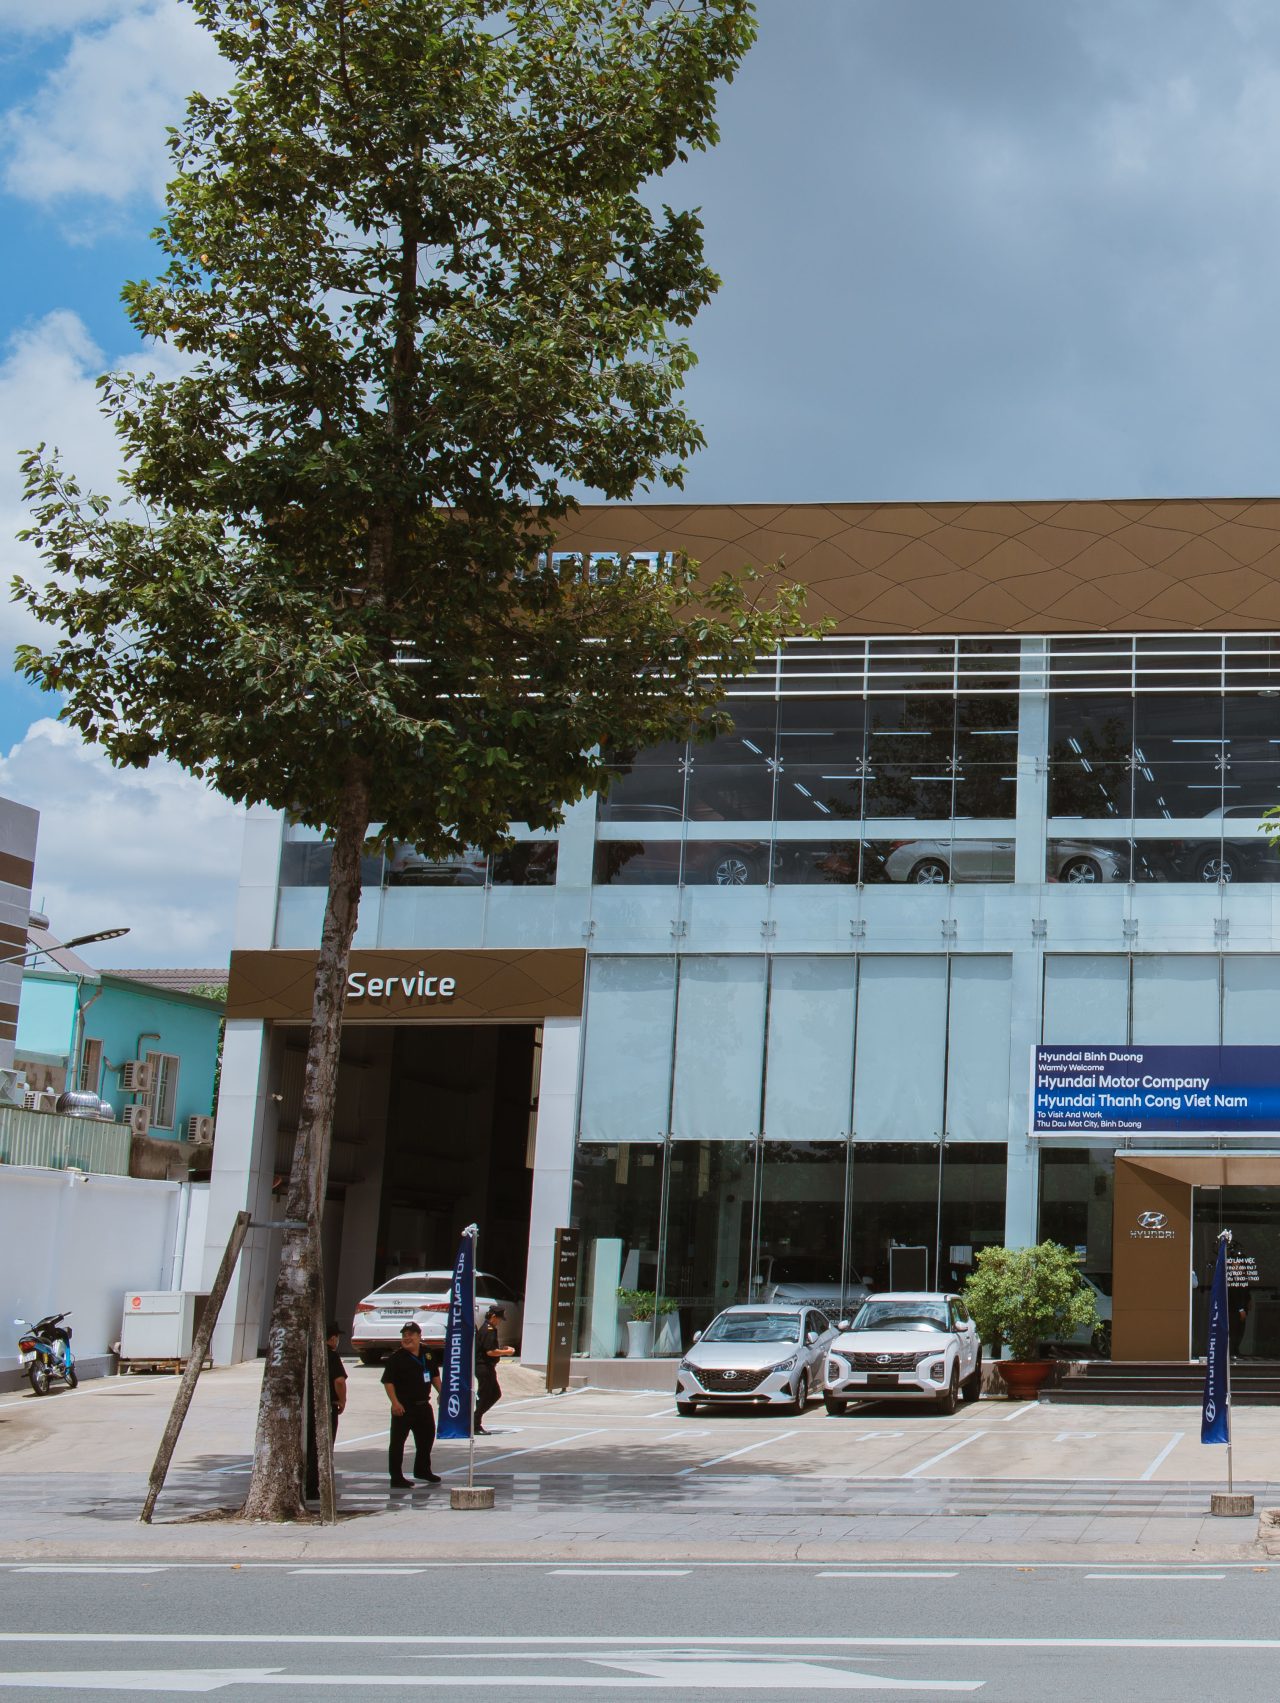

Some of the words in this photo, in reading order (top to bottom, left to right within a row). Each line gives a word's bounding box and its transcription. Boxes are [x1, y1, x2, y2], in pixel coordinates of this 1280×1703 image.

[346, 970, 457, 997] Service
[1038, 1052, 1082, 1062] Hyundai
[1084, 1052, 1107, 1061] Binh
[1109, 1052, 1143, 1063] Duong
[1038, 1063, 1068, 1072] Warmly
[1069, 1063, 1105, 1072] Welcome
[1038, 1074, 1096, 1090] Hyundai
[1099, 1075, 1140, 1088] Motor
[1142, 1074, 1210, 1090] Company
[1037, 1093, 1096, 1109] Hyundai
[1098, 1093, 1142, 1107] Thanh
[1144, 1094, 1181, 1110] Cong
[1184, 1093, 1211, 1107] Viet
[1214, 1094, 1248, 1107] Nam
[1047, 1110, 1065, 1118] Visit
[1065, 1110, 1081, 1118] And
[1081, 1110, 1102, 1118] Work
[1037, 1119, 1051, 1128] Thu
[1051, 1119, 1067, 1128] Dau
[1068, 1119, 1083, 1128] Mot
[1083, 1119, 1100, 1129] City,
[1100, 1119, 1117, 1128] Binh
[1117, 1120, 1142, 1129] Duong
[1130, 1230, 1175, 1239] HYUNDAI
[454, 1252, 465, 1306] MOTOR
[453, 1307, 462, 1327] TC
[450, 1333, 462, 1391] HYUNDAI
